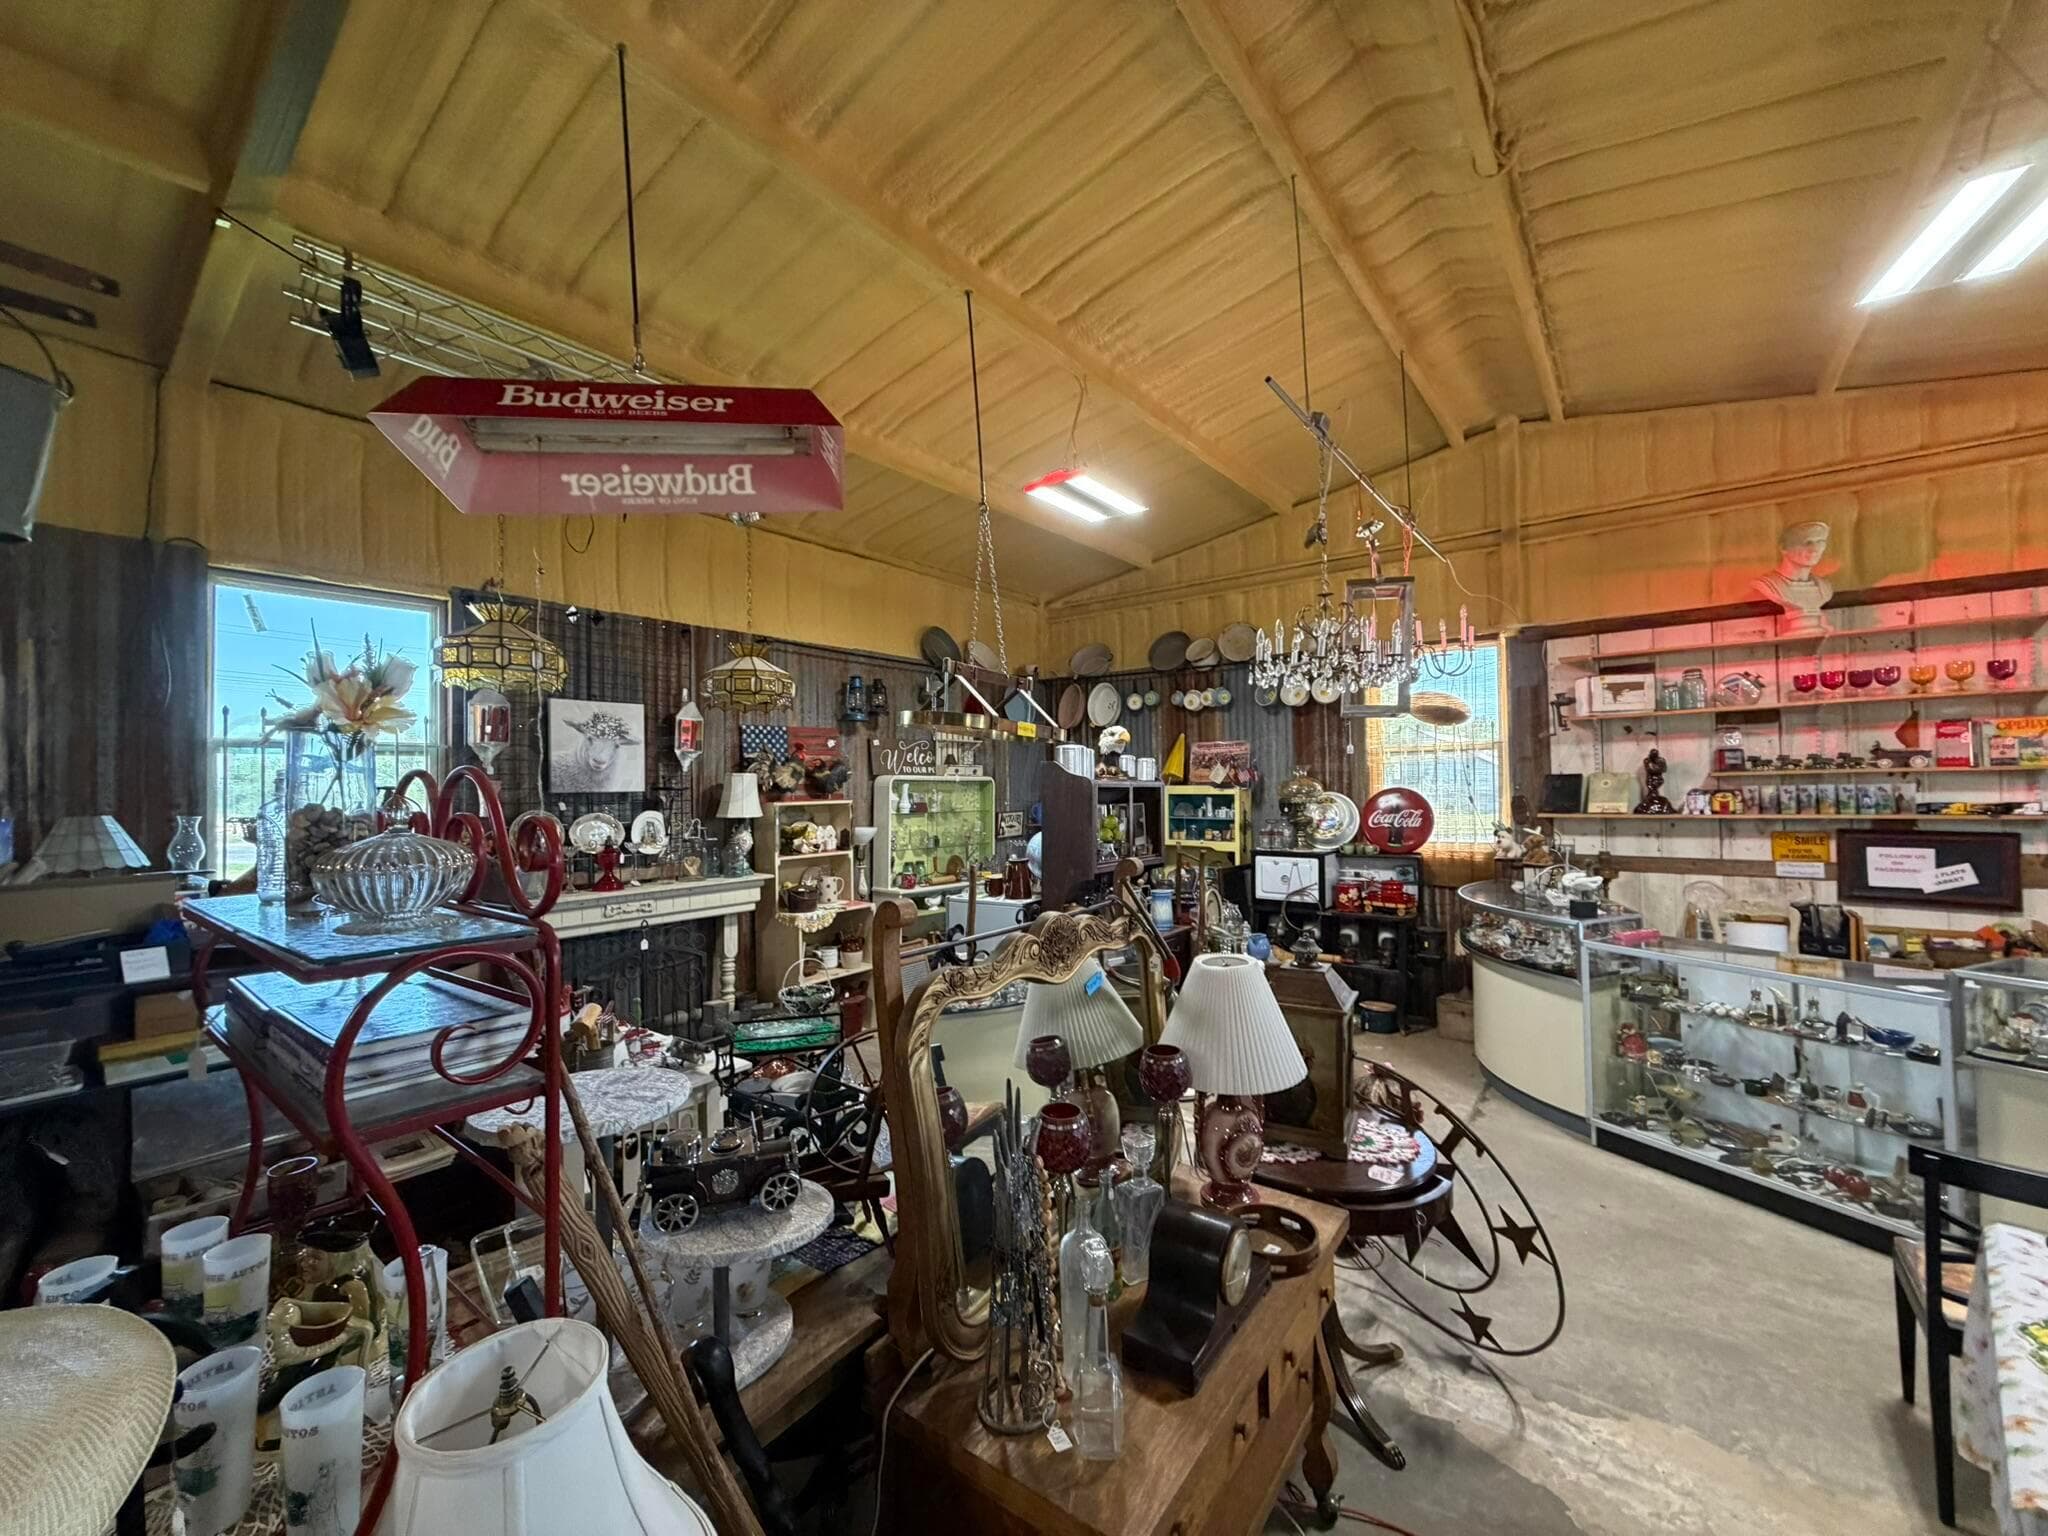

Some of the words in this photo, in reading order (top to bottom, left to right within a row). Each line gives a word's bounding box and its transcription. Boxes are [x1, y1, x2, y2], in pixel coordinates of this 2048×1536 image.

[497, 384, 734, 413] Budweiser
[574, 408, 605, 416] KING
[880, 740, 935, 775] Welco
[903, 766, 912, 774] TO
[1367, 809, 1424, 829] Coca-Cola
[1794, 835, 1825, 846] SMILE
